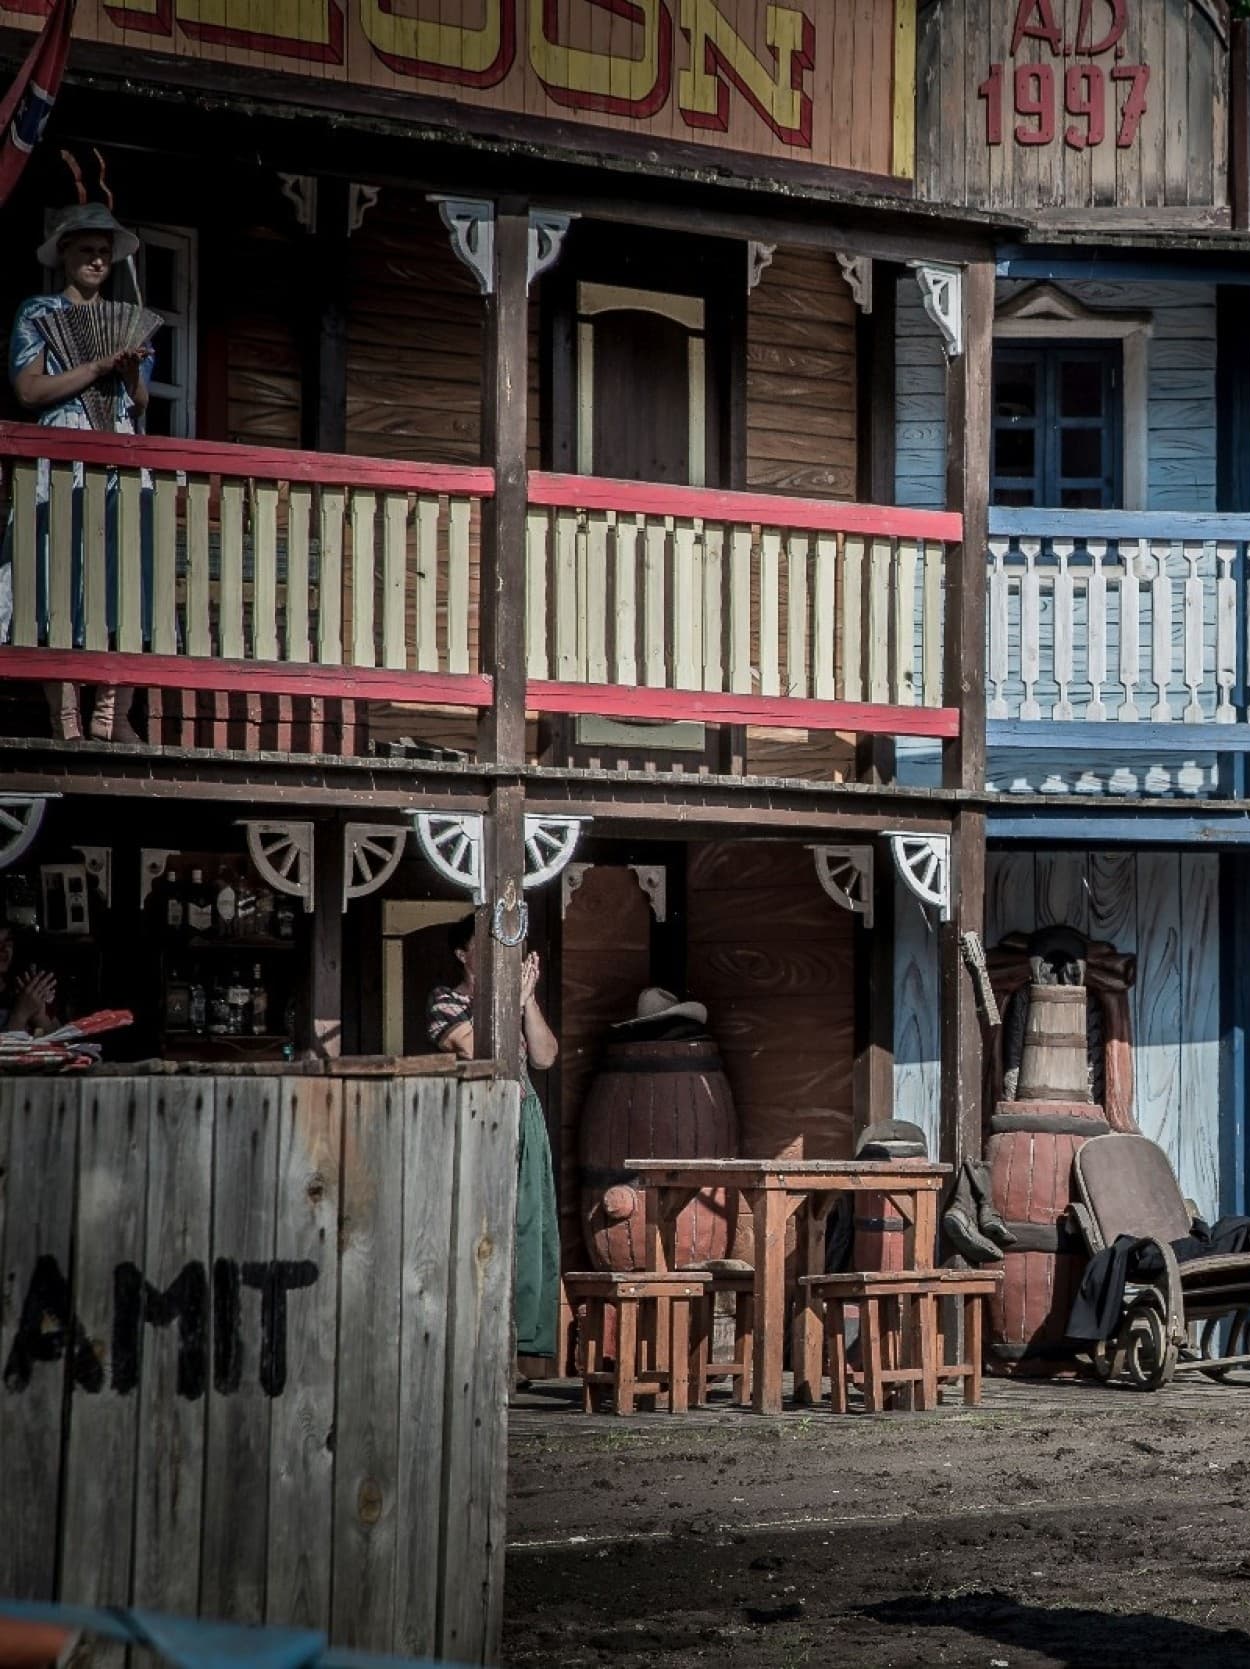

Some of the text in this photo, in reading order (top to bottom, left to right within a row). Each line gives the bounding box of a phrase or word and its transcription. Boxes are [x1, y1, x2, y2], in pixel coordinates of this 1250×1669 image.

[0, 0, 815, 148] OON
[977, 63, 1151, 151] 1997
[3, 1254, 319, 1400] AMIT
